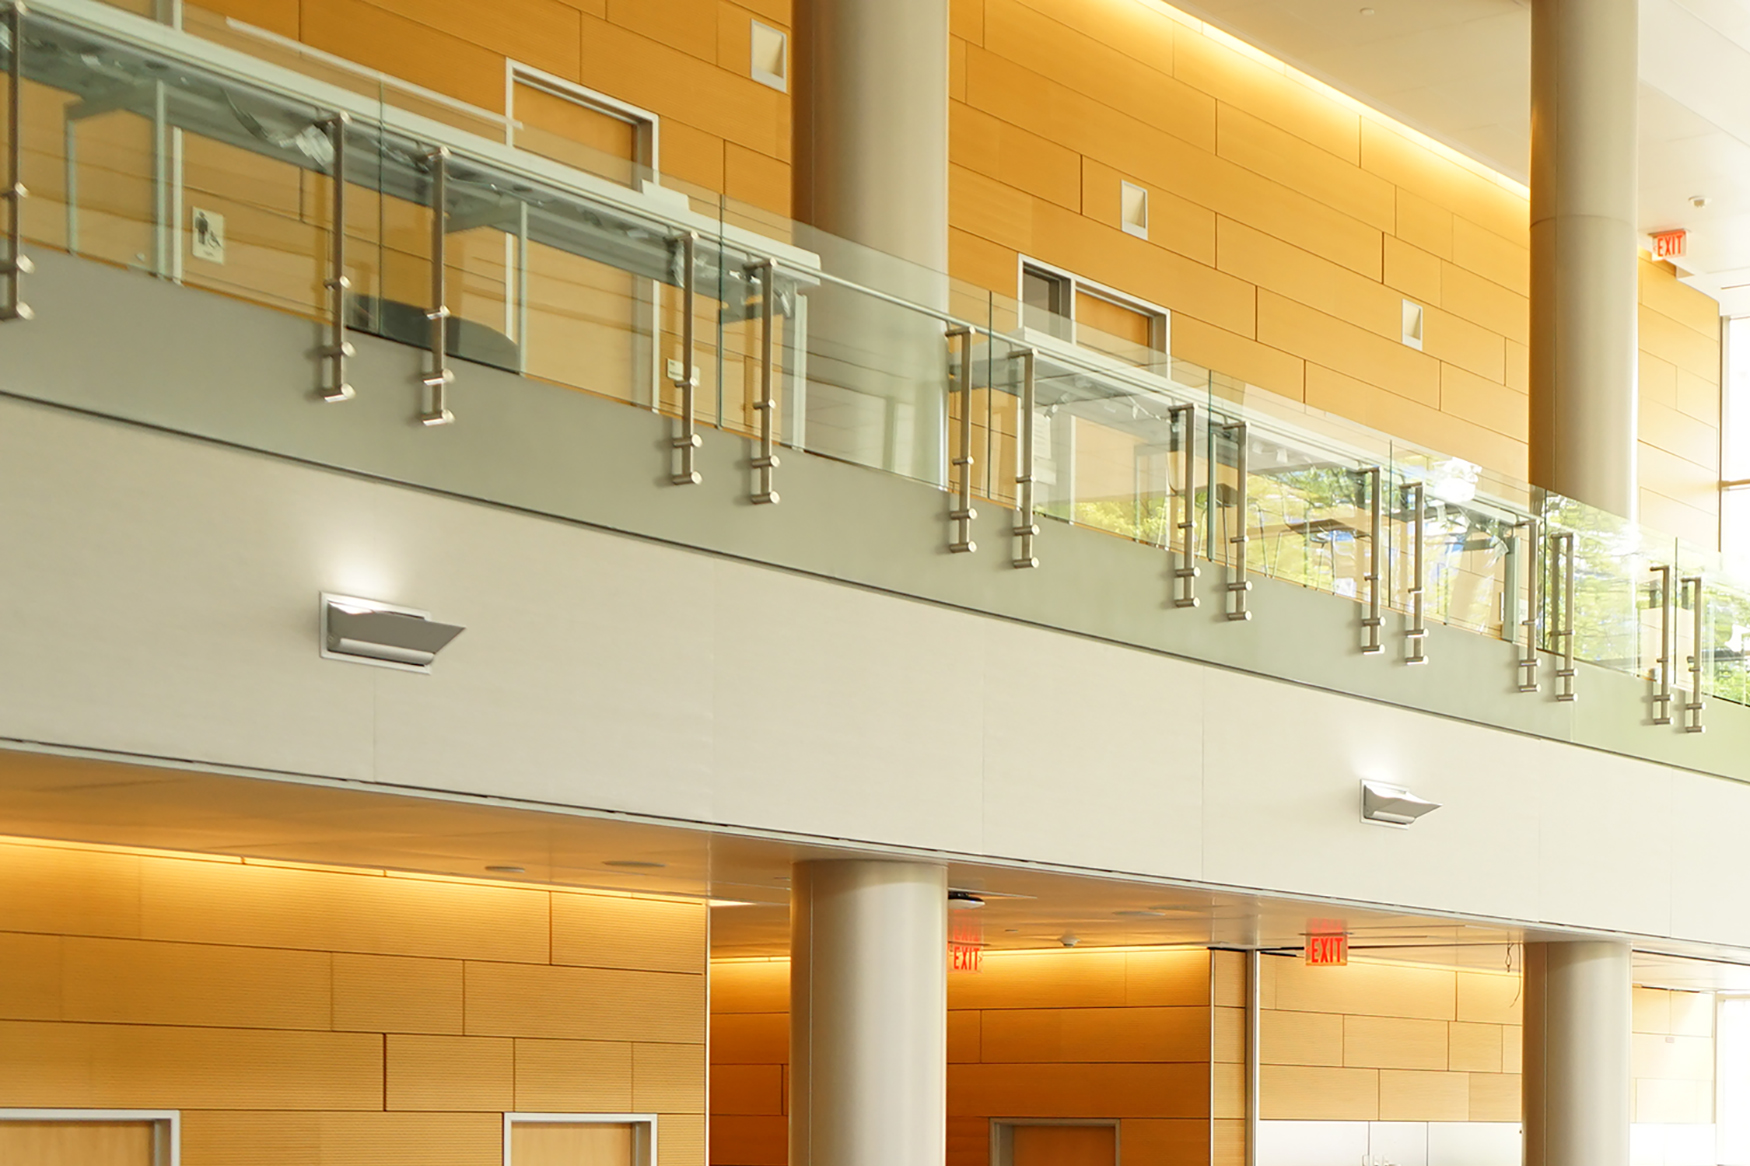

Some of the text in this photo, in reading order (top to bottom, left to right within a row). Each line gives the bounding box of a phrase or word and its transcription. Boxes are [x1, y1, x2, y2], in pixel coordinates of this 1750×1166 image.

[1657, 234, 1683, 257] EXIT
[953, 946, 980, 970] EXIT
[1311, 937, 1344, 963] EXIT
